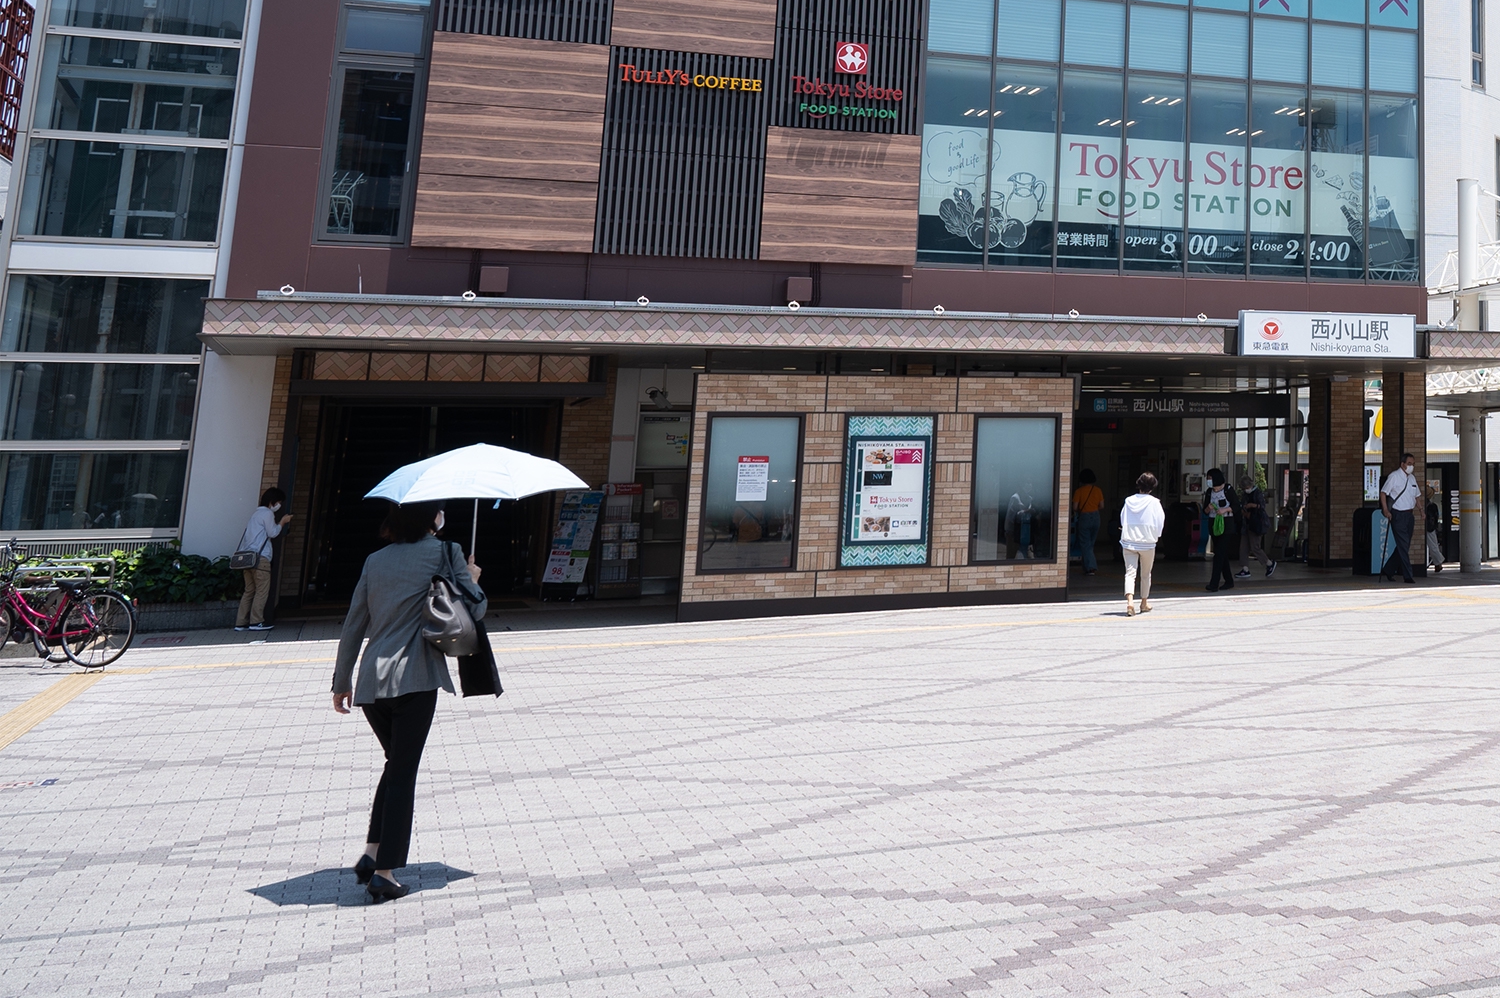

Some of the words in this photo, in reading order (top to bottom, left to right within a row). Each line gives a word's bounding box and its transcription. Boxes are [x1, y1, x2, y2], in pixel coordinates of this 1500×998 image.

[693, 74, 762, 92] COFFEE
[792, 75, 850, 99] Tokyu
[854, 80, 903, 102] Store
[800, 103, 838, 115] FOOD
[842, 106, 897, 120] STATION
[1069, 142, 1195, 189] Tokyu
[1203, 151, 1304, 190] Store
[1077, 188, 1161, 210] FOOD
[1173, 193, 1292, 218] STATON
[1056, 232, 1109, 248] 営業時間
[1125, 234, 1158, 246] open
[1252, 239, 1284, 252] close
[1311, 318, 1389, 341] 西小山駅
[1252, 341, 1290, 351] 東急電鉄
[1310, 342, 1372, 355] Nishi-koyama
[1373, 344, 1391, 353] Sta.
[1133, 398, 1184, 413] 西小山駅
